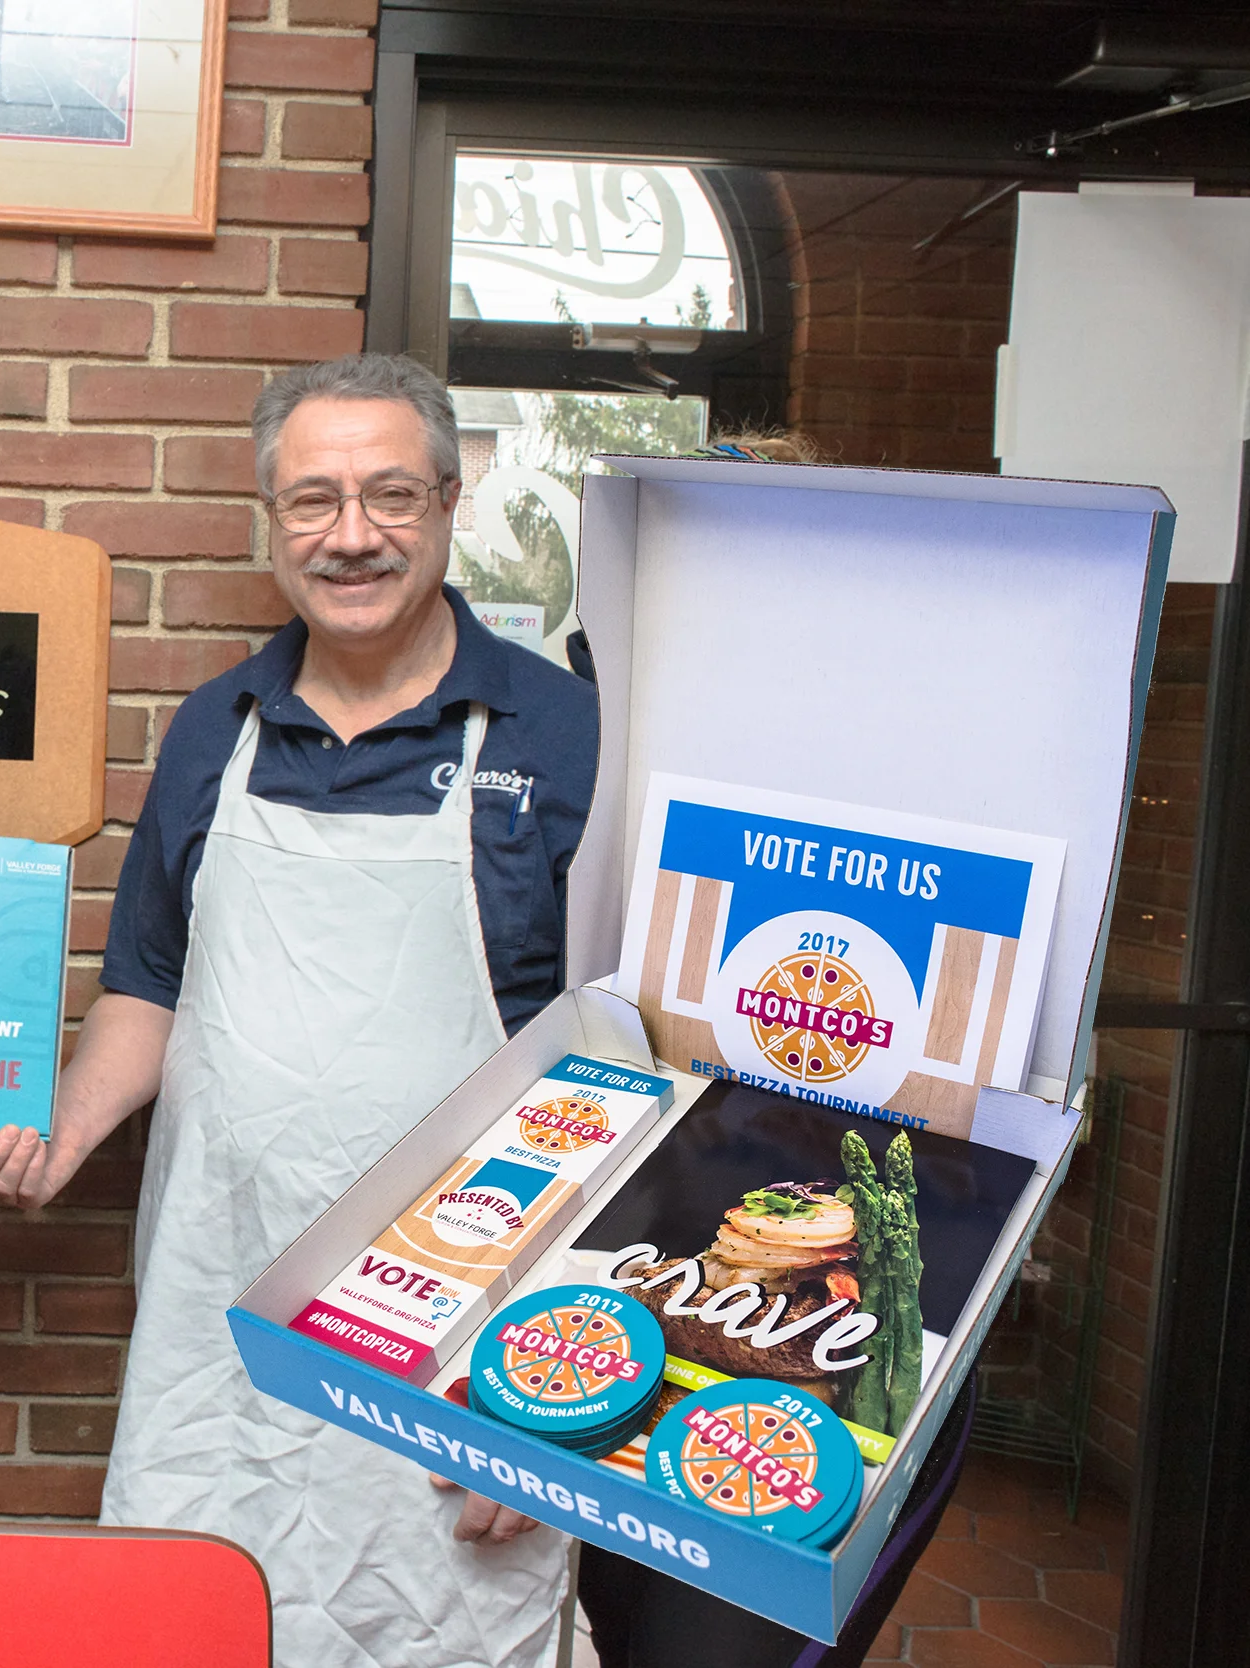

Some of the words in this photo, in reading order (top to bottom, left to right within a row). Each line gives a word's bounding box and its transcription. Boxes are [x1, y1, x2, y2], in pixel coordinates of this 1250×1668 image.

[6, 861, 35, 869] VALLEY
[36, 863, 61, 871] FORGE
[744, 829, 820, 878] VOTE
[827, 846, 888, 892] FOR
[898, 858, 943, 901] US
[797, 932, 850, 958] 2017
[741, 990, 889, 1044] MONTCO'S
[566, 1062, 603, 1080] VOTE
[600, 1071, 630, 1088] FOR
[629, 1079, 652, 1093] US
[572, 1089, 607, 1103] 2017
[691, 1058, 736, 1081] BEST
[739, 1071, 791, 1097] PIZZA
[796, 1085, 930, 1131] TOURNAMENT
[521, 1107, 613, 1142] MONTCO'S
[504, 1145, 532, 1159] BEST
[530, 1153, 562, 1169] PIZZA
[436, 1212, 469, 1228] VALLEY
[468, 1223, 498, 1239] FORGE
[438, 1192, 515, 1218] PRESENTED
[505, 1215, 525, 1230] BY
[357, 1255, 442, 1301] VOTE
[438, 1286, 461, 1299] NOW
[339, 1286, 437, 1331] VALLEYFORGE.ORG/PIZZA
[573, 1293, 624, 1315] 2017
[597, 1242, 878, 1371] crave
[307, 1311, 414, 1364] #MONTCOPIZZA
[502, 1325, 639, 1379] MONTCO'S
[482, 1366, 503, 1391] BEST
[497, 1387, 525, 1410] PIZZA
[526, 1400, 610, 1418] TOURNAMENT
[772, 1394, 823, 1429] 2017
[319, 1379, 711, 1569] VALLEYFORGE.ORG
[658, 1450, 675, 1478] BEST
[689, 1411, 820, 1508] MONTCO'S
